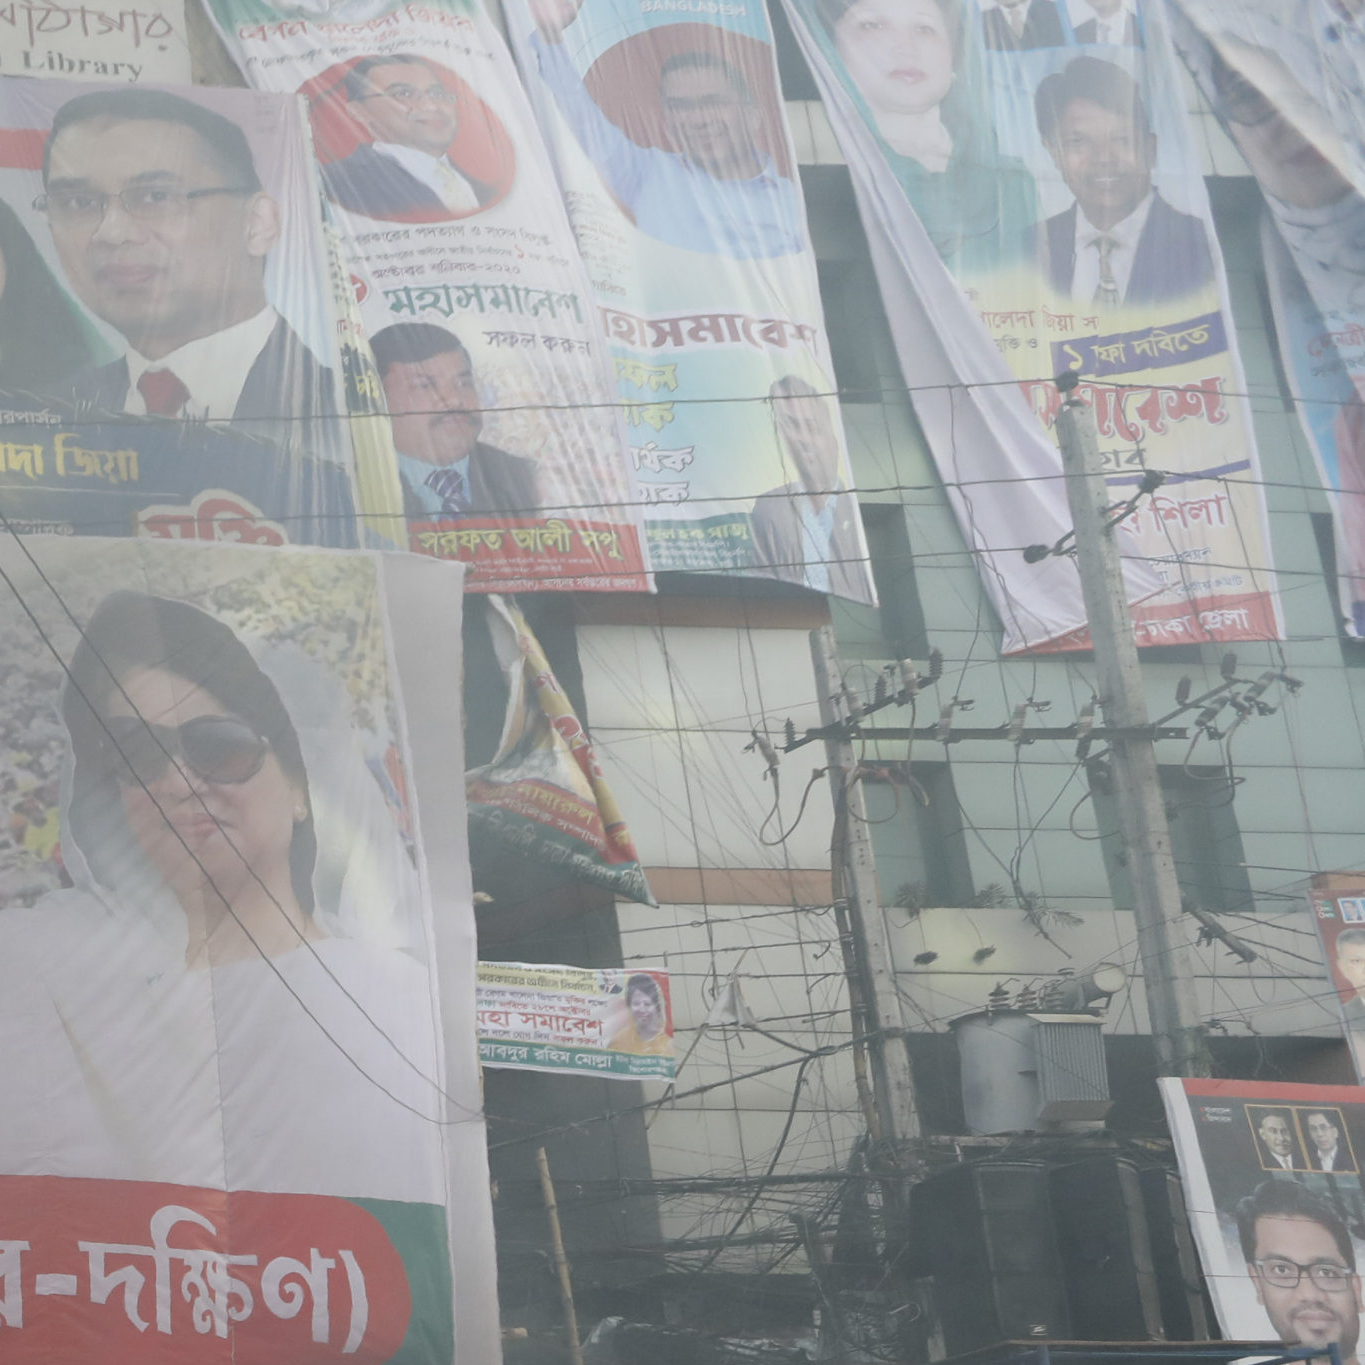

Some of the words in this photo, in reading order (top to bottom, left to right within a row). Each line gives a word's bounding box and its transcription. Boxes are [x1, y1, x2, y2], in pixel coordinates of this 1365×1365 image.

[23, 49, 143, 83] Library
[382, 282, 586, 325] মহাসমাবেশ
[481, 329, 538, 351] সফল
[540, 335, 592, 358] করুন
[54, 432, 141, 484] জিয়া
[509, 518, 576, 553] আলী
[519, 1012, 605, 1037] সমাবেশ
[478, 1043, 530, 1062] আবদুর
[533, 1045, 571, 1064] রহিম
